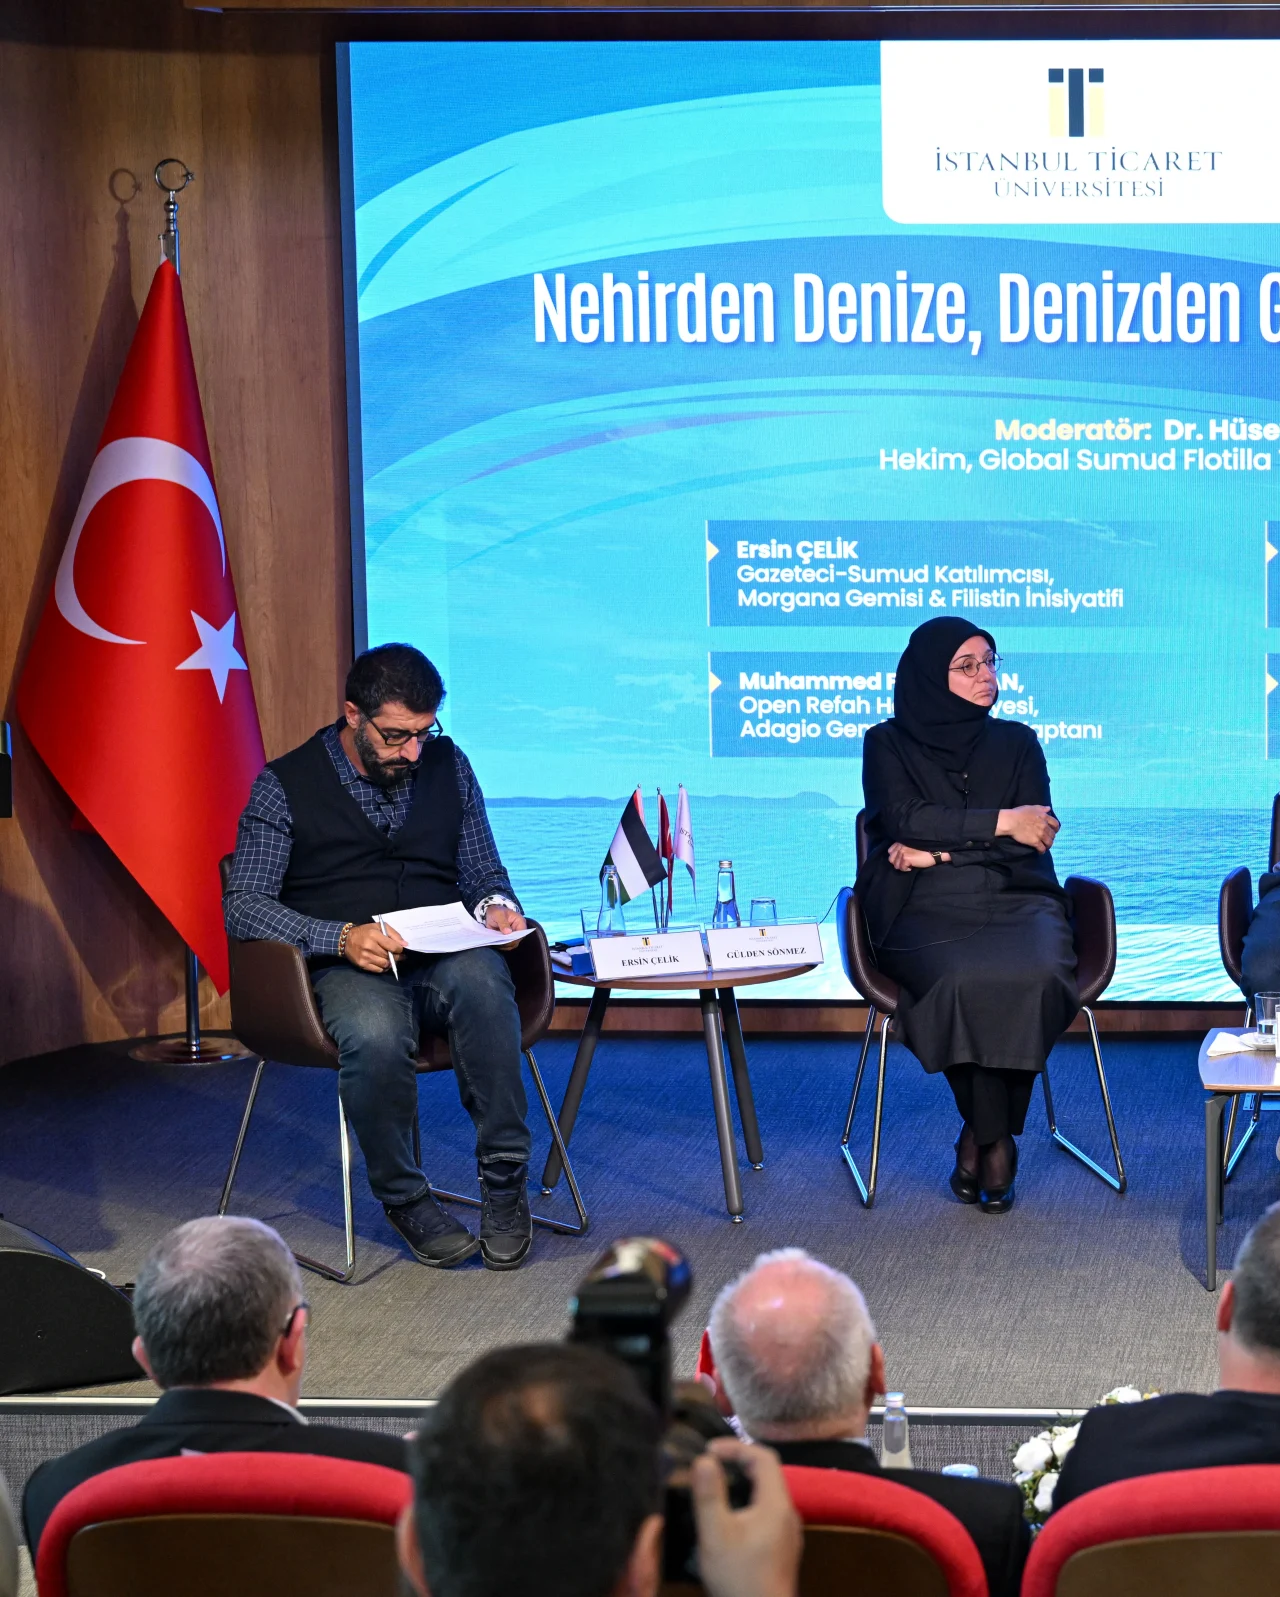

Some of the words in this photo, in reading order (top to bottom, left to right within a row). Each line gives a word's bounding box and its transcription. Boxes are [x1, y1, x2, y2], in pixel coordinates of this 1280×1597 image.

[936, 146, 1077, 172] İSTANBUL
[1089, 146, 1223, 172] TİCARET
[994, 177, 1163, 197] ÜNİVERSİTESİ
[533, 270, 775, 343] Nehirden
[793, 270, 982, 356] Denize,
[999, 271, 1240, 343] Denizden
[995, 417, 1152, 441] Moderatör:
[1164, 419, 1204, 441] Dr.
[879, 447, 973, 475] Hekim,
[979, 447, 1069, 471] Global
[1077, 447, 1176, 471] Sumud
[1184, 447, 1271, 471] Flotilla
[737, 539, 792, 559] Ersin
[796, 537, 859, 564] ÇELİK
[737, 564, 929, 584] Gazeteci-Sumud
[935, 564, 1054, 587] Katılımcısı,
[738, 589, 840, 613] Morgana
[846, 588, 923, 608] Gemisi
[928, 590, 947, 608] &
[952, 588, 1020, 608] Filistin
[1026, 585, 1124, 613] İnisiyatifi
[739, 671, 882, 691] Muhammed
[739, 696, 801, 719] Open
[806, 695, 871, 715] Refah
[740, 719, 821, 744] Adagio
[1023, 720, 1103, 745] aptanı
[621, 956, 649, 967] ERSİN
[651, 954, 680, 965] ÇELİK
[727, 948, 765, 959] GÜLDEN
[767, 946, 807, 956] SÖNMEZ
